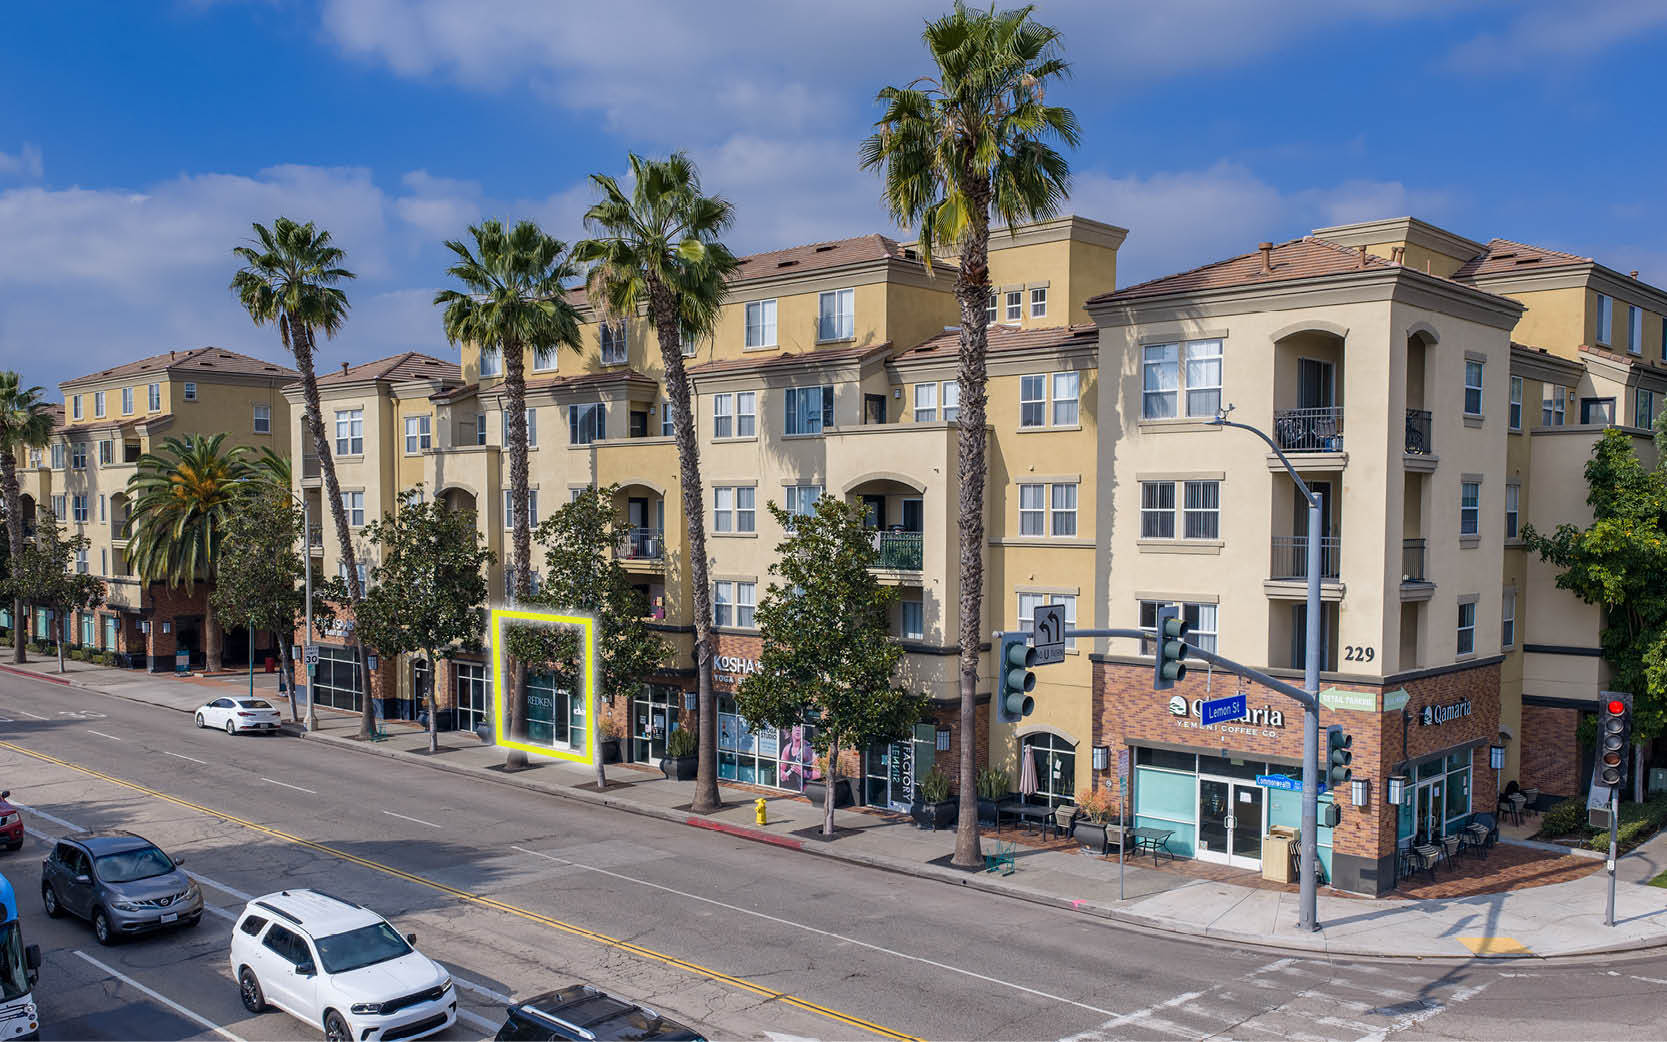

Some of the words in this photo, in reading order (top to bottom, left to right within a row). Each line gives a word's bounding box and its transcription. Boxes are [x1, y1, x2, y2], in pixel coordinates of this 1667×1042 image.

[306, 655, 318, 663] 30
[1344, 646, 1375, 663] 229
[713, 655, 755, 674] KOSHA
[714, 673, 734, 683] YOGA
[527, 695, 553, 707] REDKEN
[1192, 698, 1283, 726] Qaria
[1208, 705, 1231, 720] Lemon
[1232, 701, 1240, 714] St
[1434, 696, 1472, 726] Qamaria
[1221, 725, 1258, 736] COFFEE
[902, 746, 912, 801] FACTORY
[1257, 775, 1291, 789] Commonwealth
